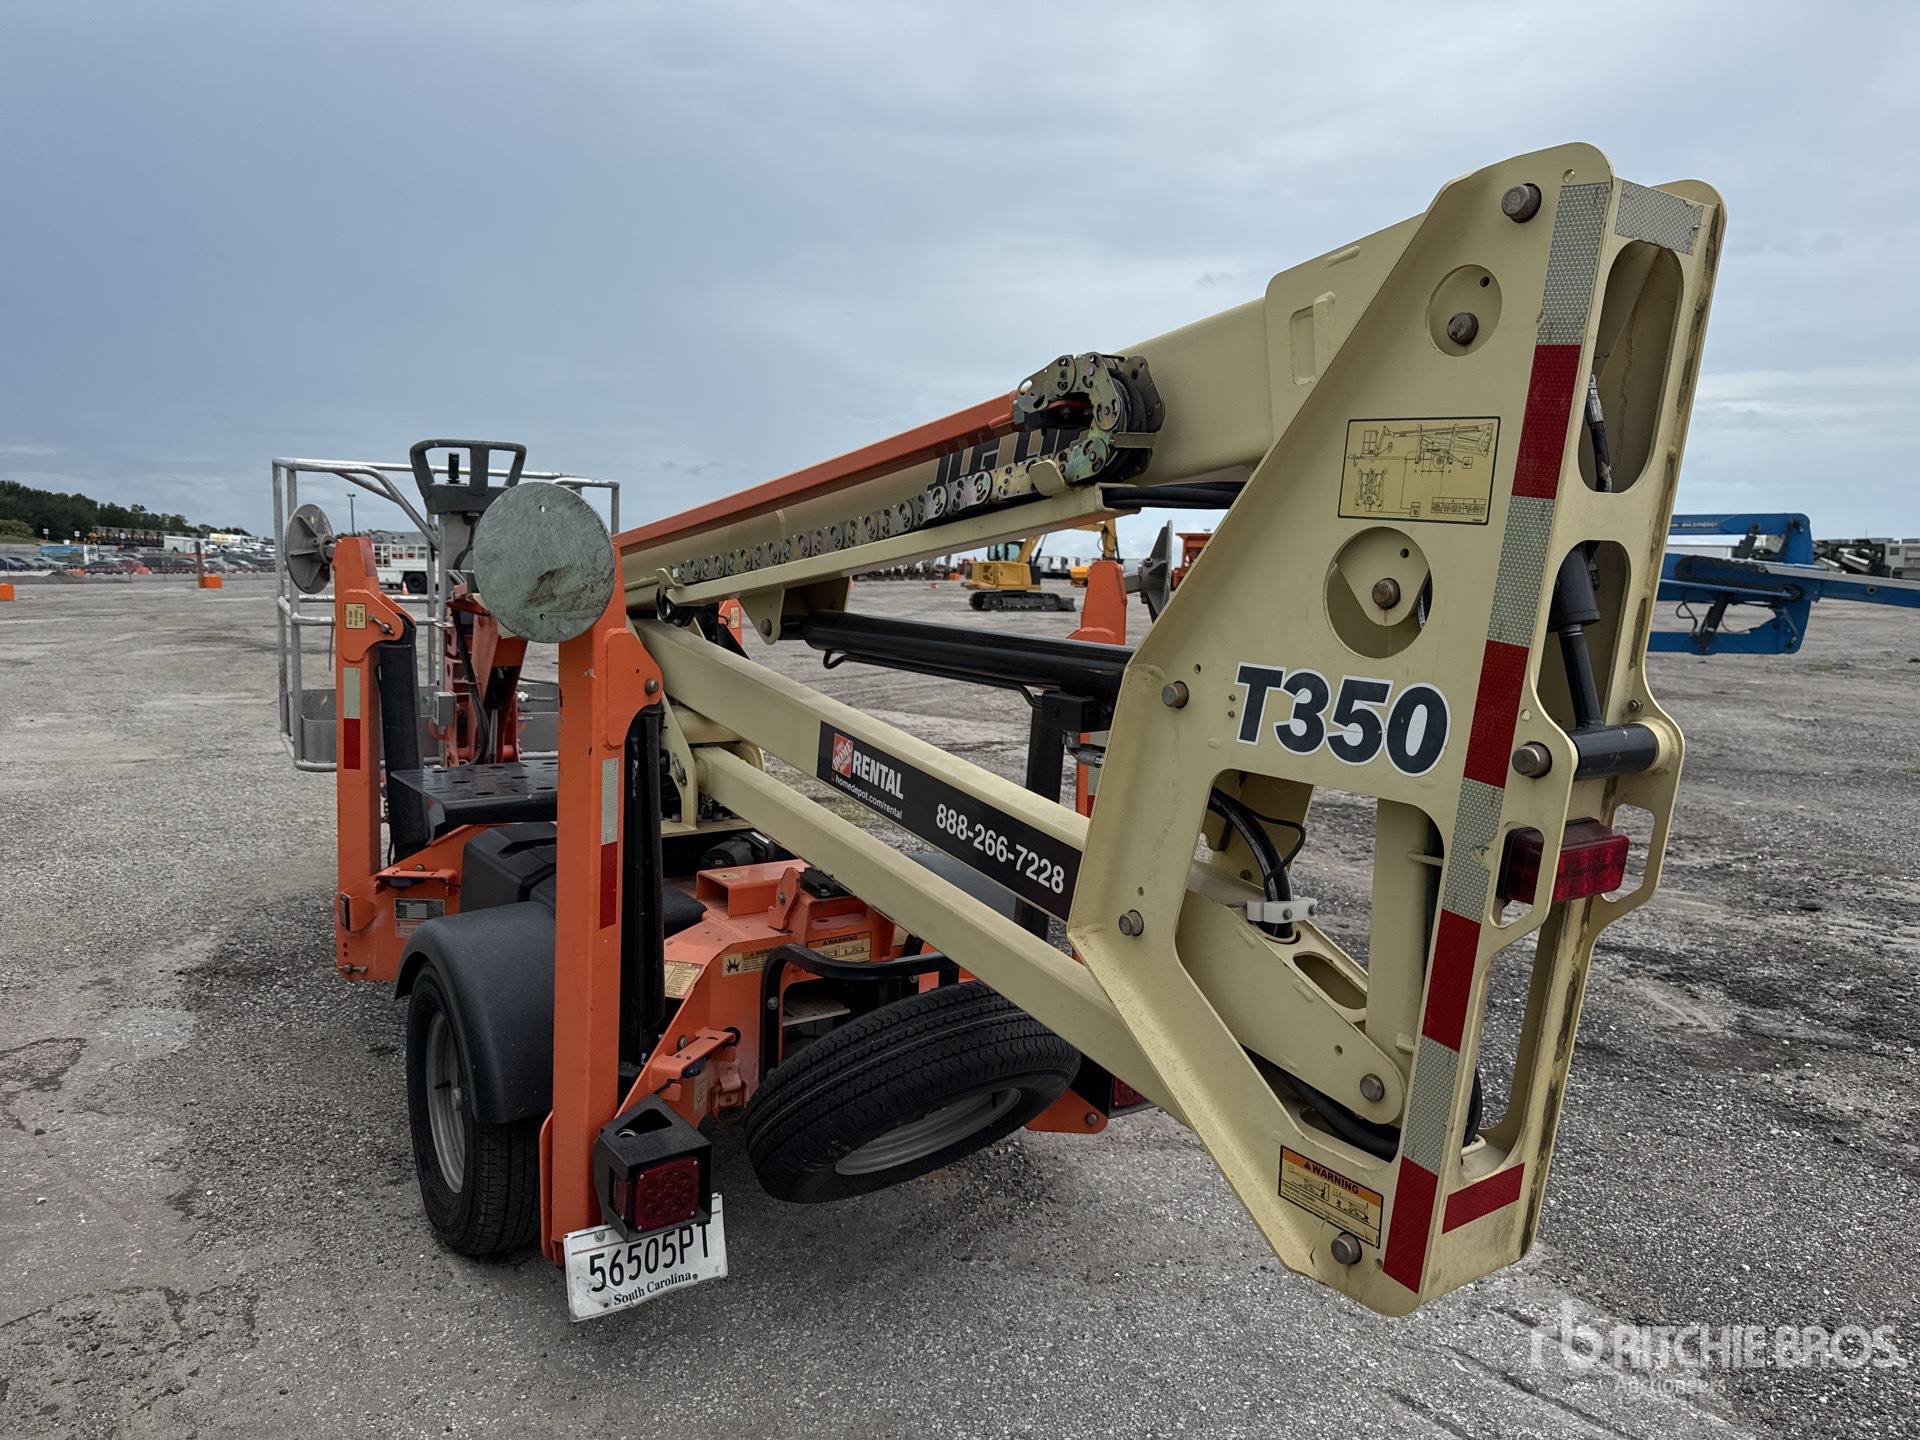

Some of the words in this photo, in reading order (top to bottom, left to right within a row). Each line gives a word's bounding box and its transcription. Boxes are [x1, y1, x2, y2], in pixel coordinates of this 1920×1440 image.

[1234, 661, 1452, 778] T350
[832, 741, 853, 770] HOME
[852, 750, 904, 800] RENTAL
[835, 774, 903, 820] homedepot.com/rental
[936, 803, 1065, 894] 888-266-7228
[827, 934, 858, 945] WARNING
[666, 960, 693, 968] DANGER
[1312, 1163, 1359, 1195] WARNING
[589, 1222, 712, 1293] 56505PT
[613, 1287, 645, 1306] South
[647, 1271, 692, 1293] Carolina
